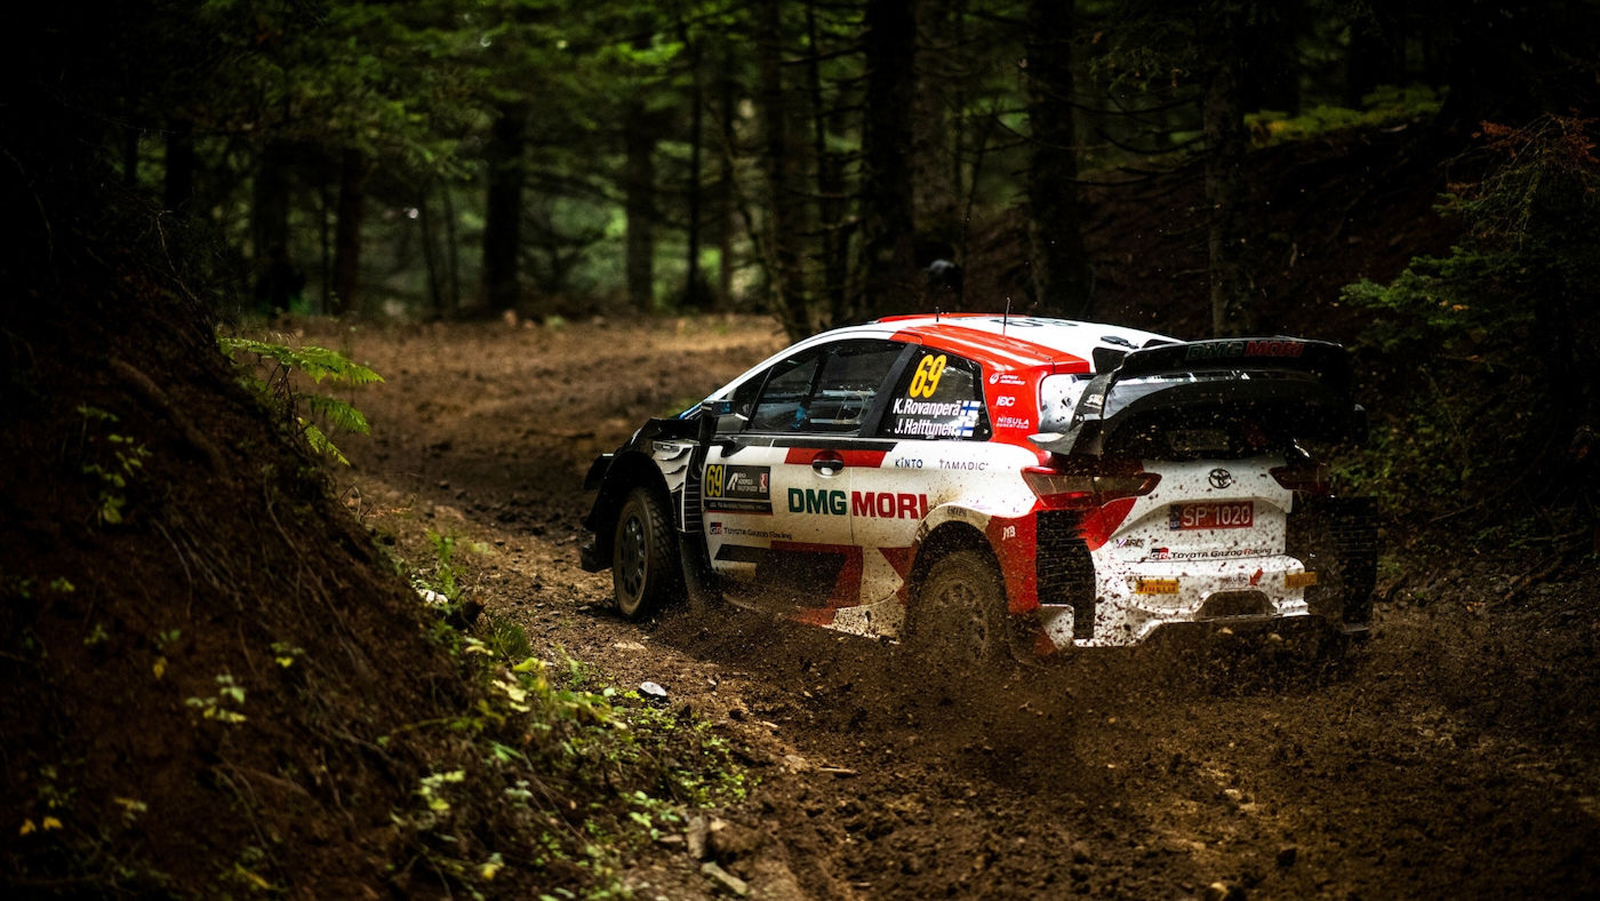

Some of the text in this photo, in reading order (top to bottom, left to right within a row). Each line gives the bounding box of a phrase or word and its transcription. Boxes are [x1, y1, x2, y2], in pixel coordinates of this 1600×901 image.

[909, 354, 947, 399] 69
[997, 417, 1029, 425] NISULA
[939, 459, 986, 471] TAMADIC
[706, 465, 723, 497] 69
[788, 488, 847, 515] DMG
[851, 491, 928, 519] MORI
[1182, 505, 1251, 527] SP 1020
[1116, 538, 1144, 549] YARIS
[1171, 551, 1208, 560] TOYOTA
[1211, 550, 1243, 558] GAZOO
